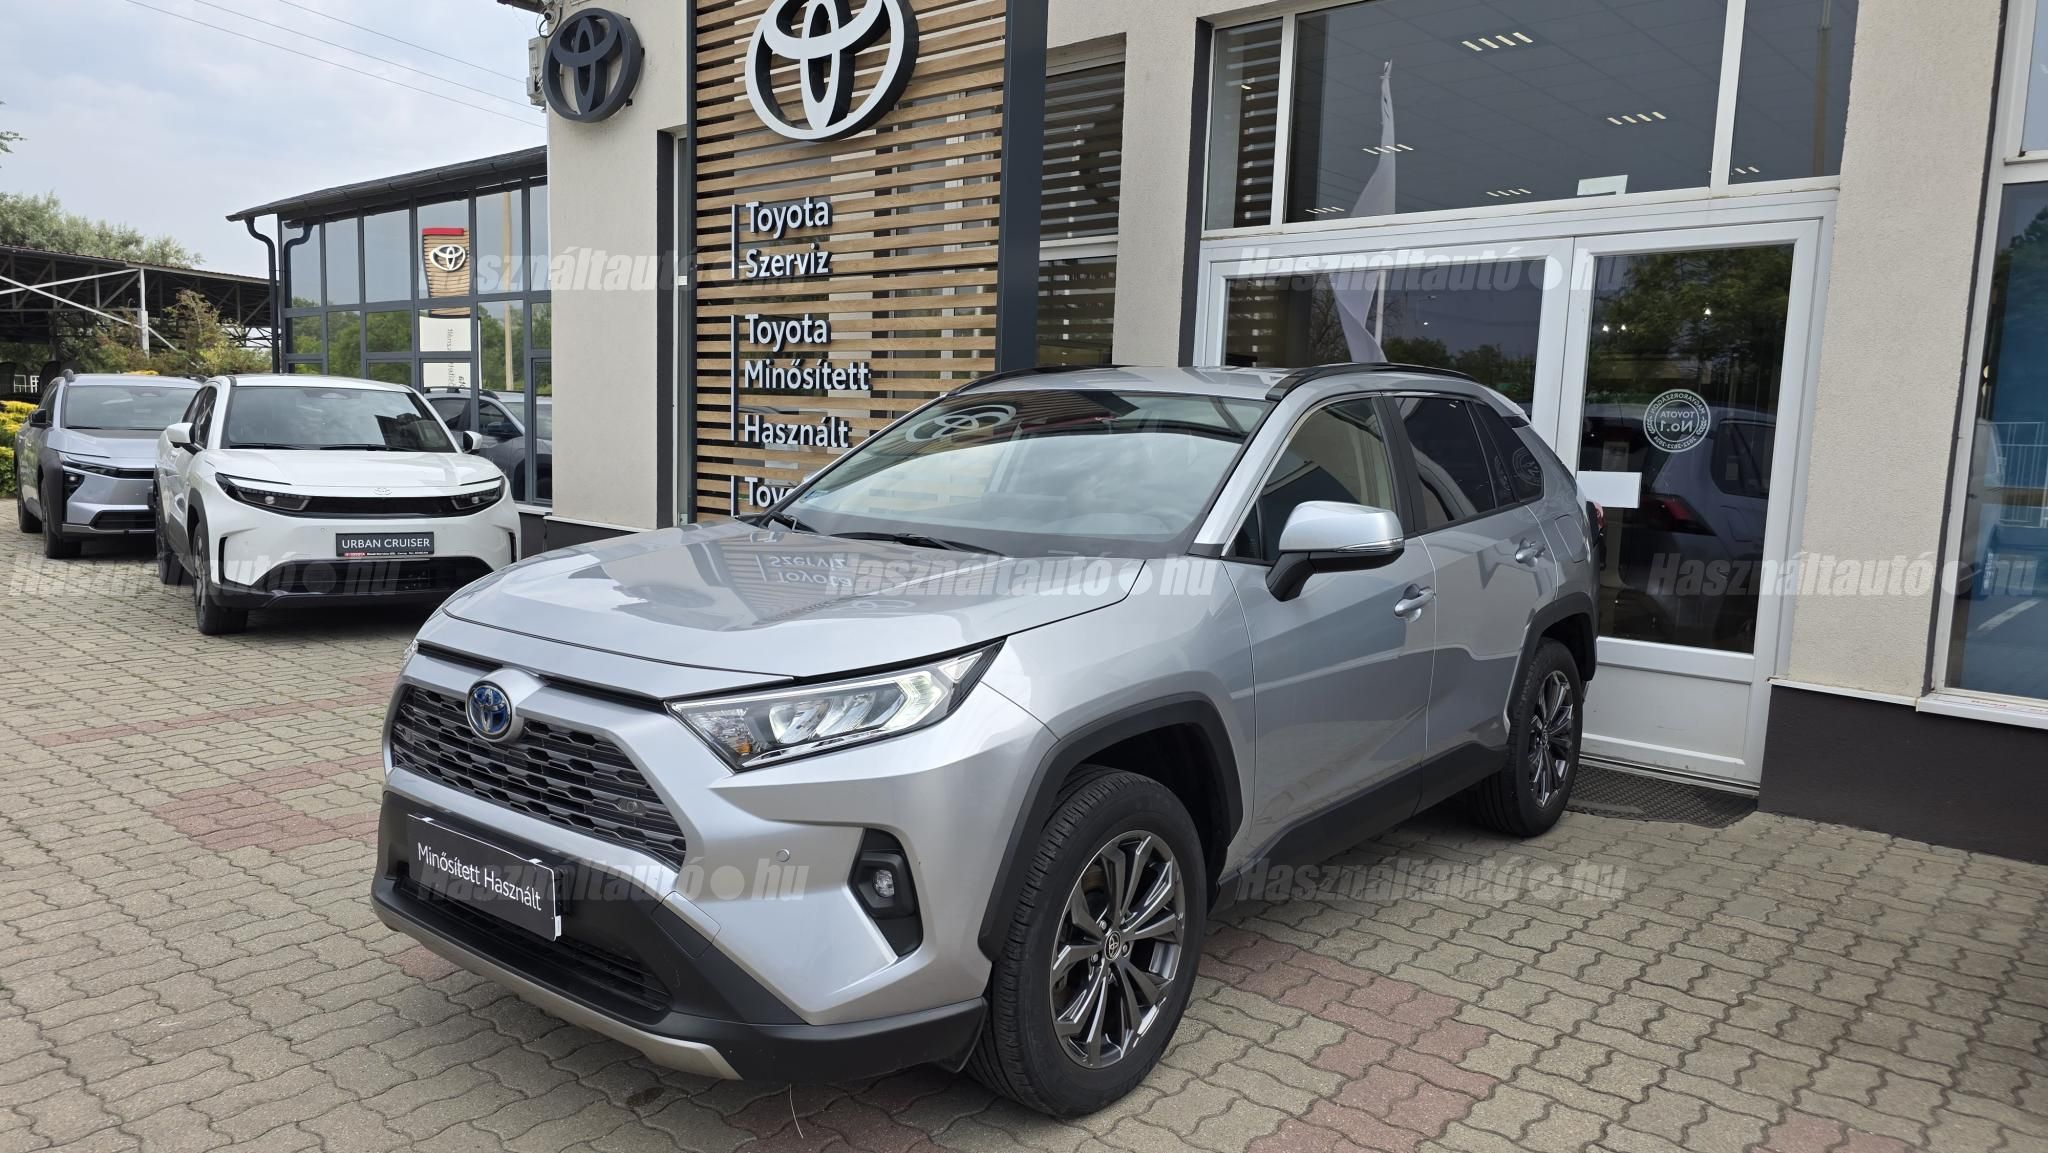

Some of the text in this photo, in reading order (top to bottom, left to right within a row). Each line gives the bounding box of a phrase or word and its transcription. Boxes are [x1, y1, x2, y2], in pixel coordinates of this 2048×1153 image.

[745, 197, 829, 240] Toyota
[745, 242, 829, 278] Szerviz
[744, 313, 828, 353] Toyota
[744, 358, 870, 391] Minősített
[744, 414, 849, 448] Használt
[341, 538, 431, 549] URBAN CRUISER
[416, 841, 543, 912] Minősített Használt
